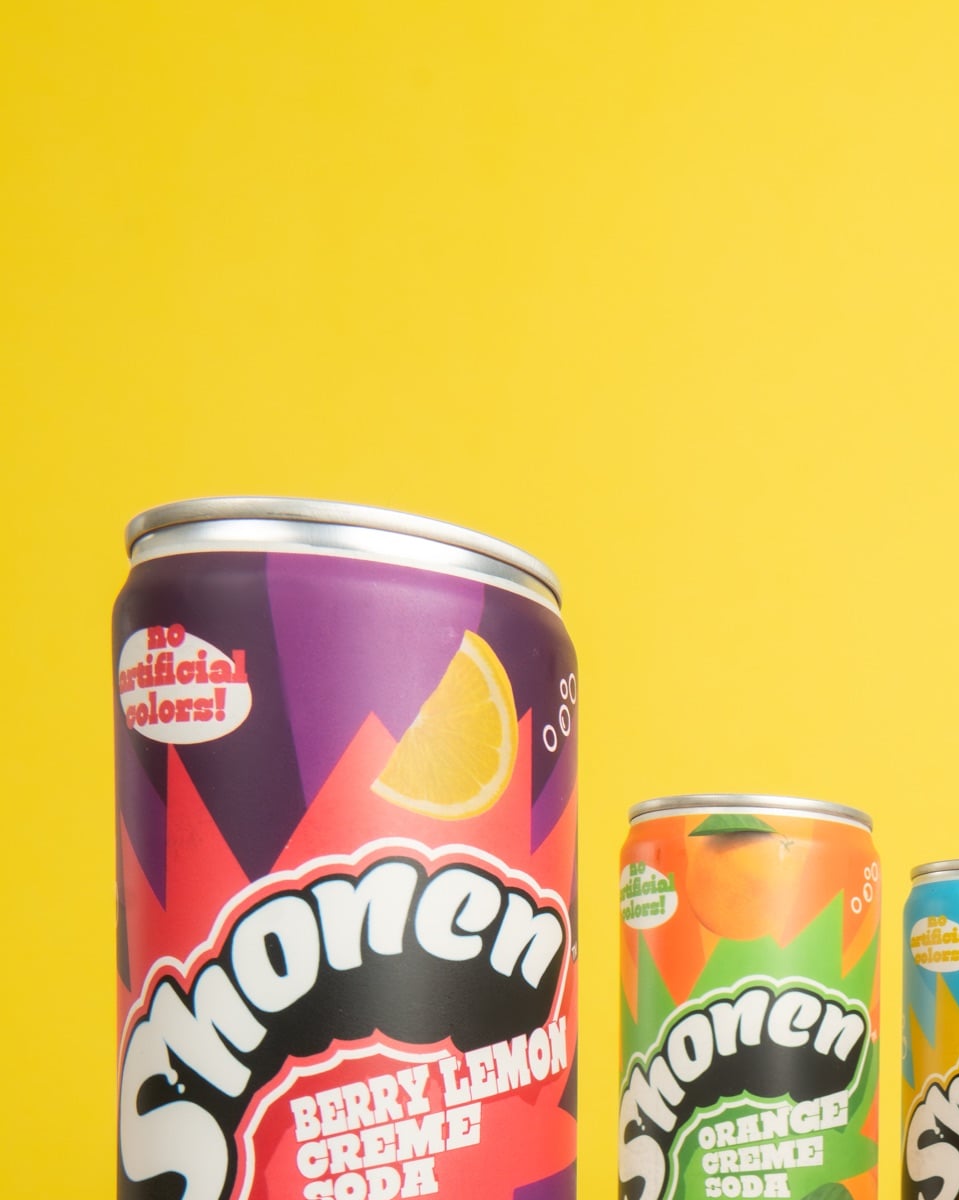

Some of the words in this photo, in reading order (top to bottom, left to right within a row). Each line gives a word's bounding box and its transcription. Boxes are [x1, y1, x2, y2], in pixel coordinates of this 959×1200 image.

[147, 623, 186, 650] no
[119, 650, 248, 695] artificial
[126, 687, 227, 730] colors!
[290, 1064, 431, 1142] BERRY
[438, 1016, 568, 1107] LEMON
[296, 1102, 482, 1179] CREME
[698, 1089, 849, 1150] ORANGE
[702, 1135, 824, 1175] CREME
[705, 1172, 791, 1199] SODA
